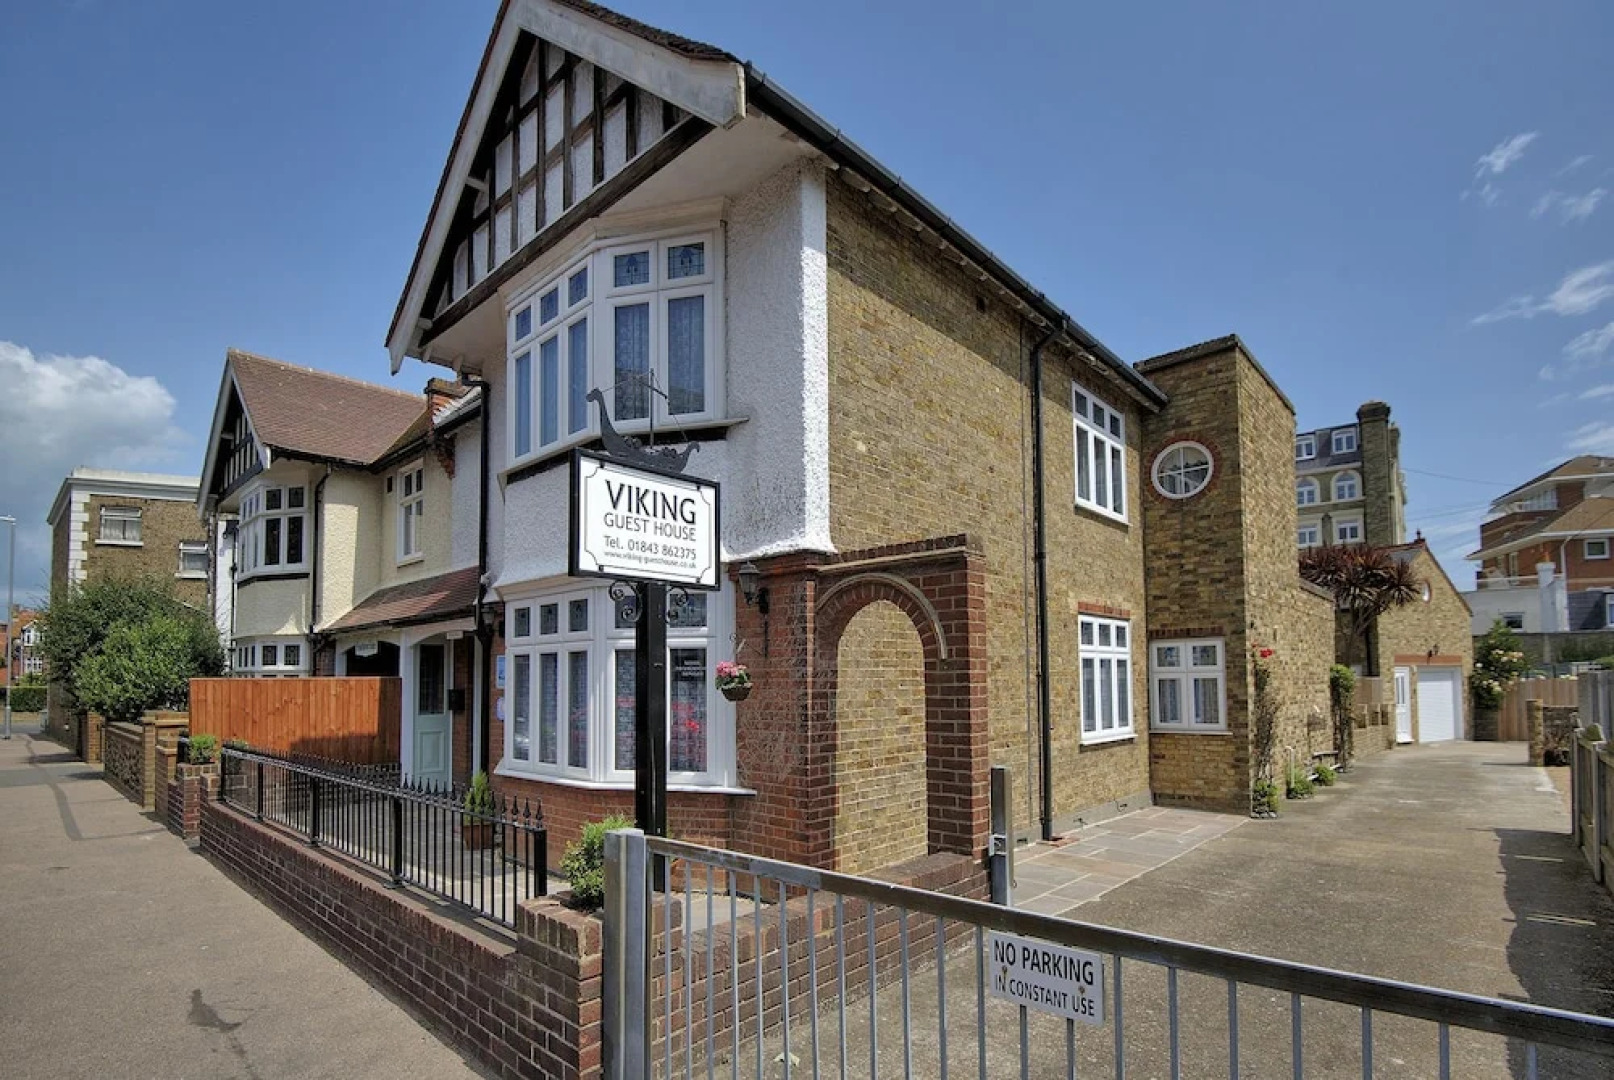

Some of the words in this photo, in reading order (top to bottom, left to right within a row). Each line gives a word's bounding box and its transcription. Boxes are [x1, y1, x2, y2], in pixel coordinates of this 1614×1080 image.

[605, 479, 696, 525] VIKING
[603, 512, 649, 533] GUEST
[654, 521, 697, 542] HOUSE
[604, 535, 624, 550] Tel.
[627, 538, 658, 555] 01843
[662, 544, 697, 561] 862375
[994, 940, 1016, 966] NO
[1022, 946, 1094, 986] PARKING
[995, 974, 1006, 992] IN
[1010, 978, 1068, 1009] CONSTANT
[1071, 995, 1095, 1017] USE
